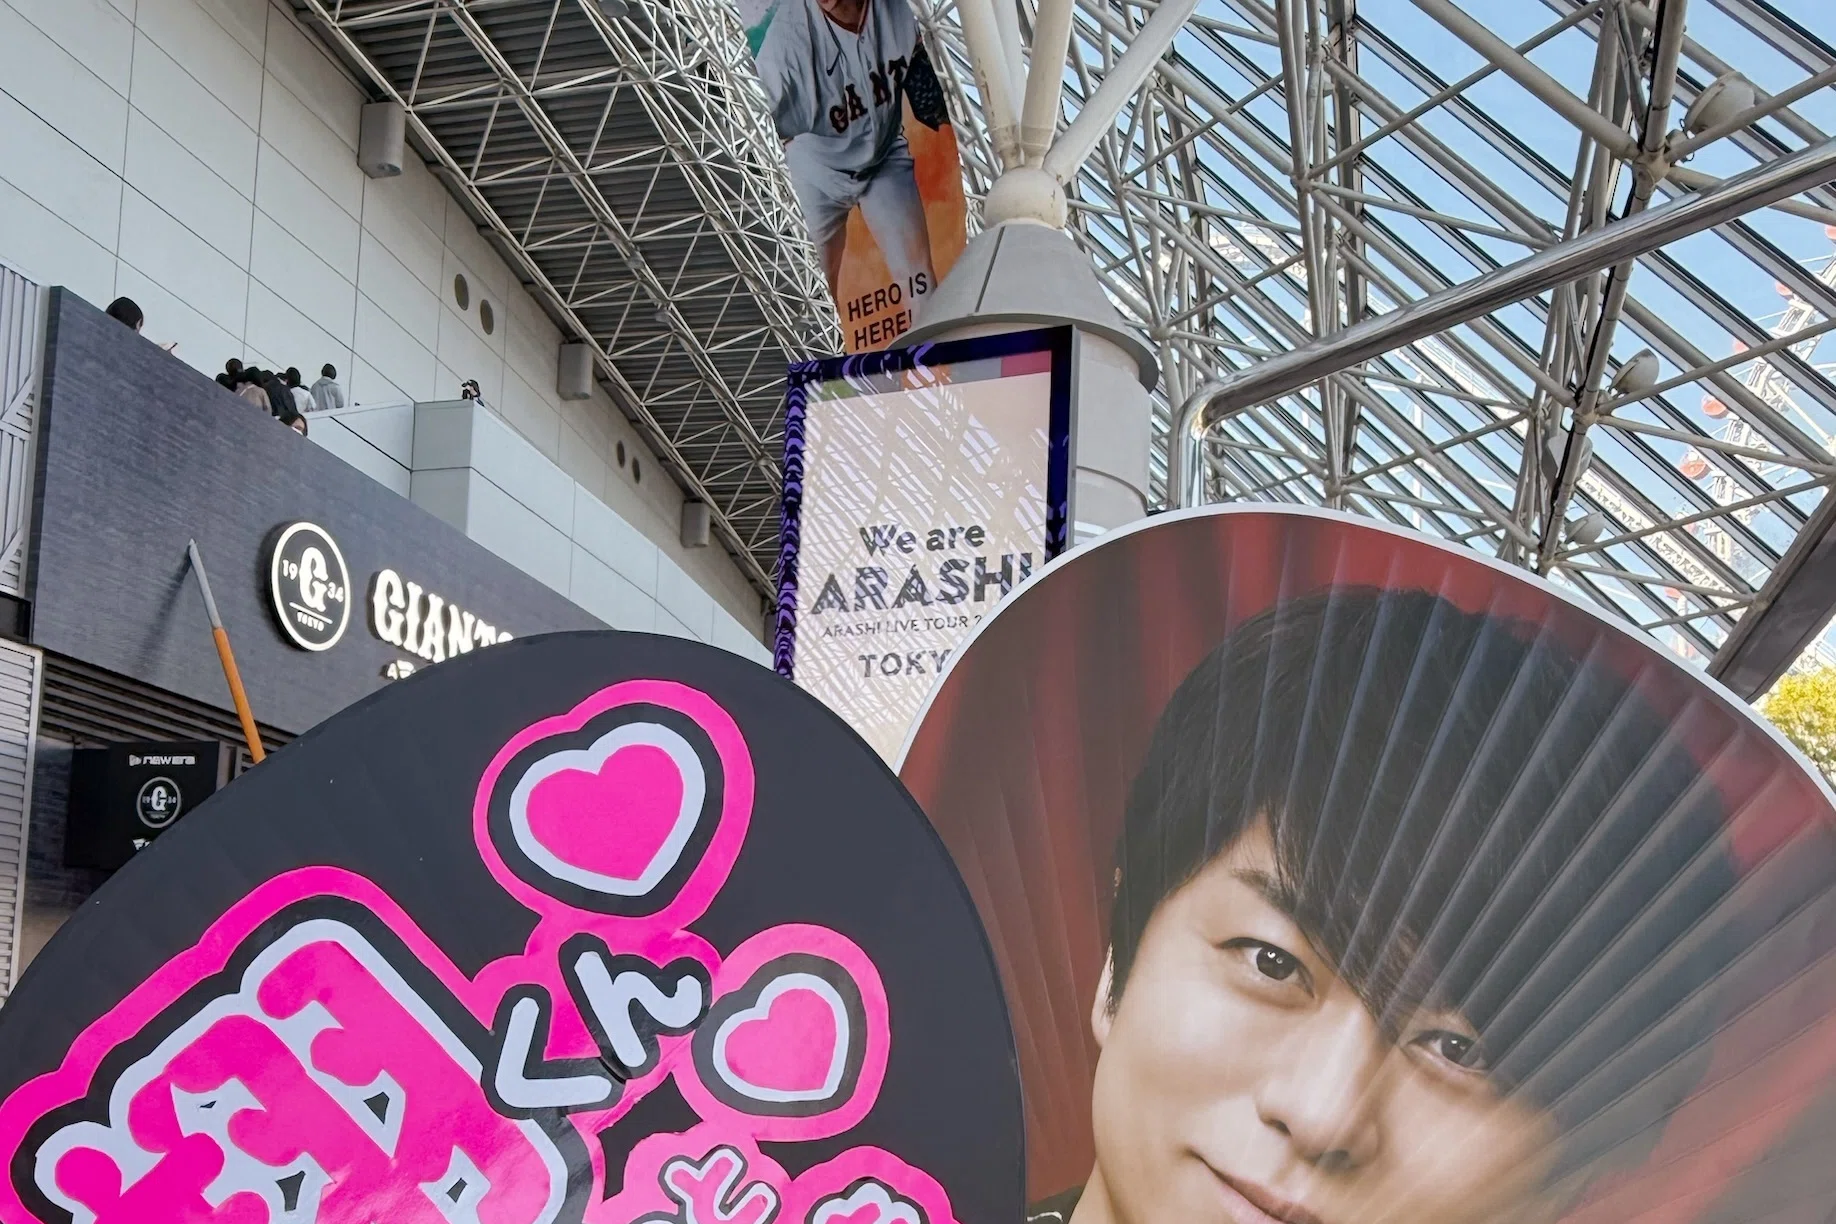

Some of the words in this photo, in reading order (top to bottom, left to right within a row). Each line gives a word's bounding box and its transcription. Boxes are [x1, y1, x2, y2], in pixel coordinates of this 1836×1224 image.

[847, 282, 902, 322] HERO
[909, 272, 928, 298] IS
[858, 523, 917, 557] We
[926, 524, 986, 551] are
[282, 559, 298, 580] 19
[299, 546, 329, 612] G
[327, 581, 344, 602] 34
[373, 568, 514, 664] GIANT
[822, 620, 881, 639] ARASHI
[886, 618, 919, 634] LIVE
[924, 614, 969, 630] TOUR
[151, 786, 168, 811] G
